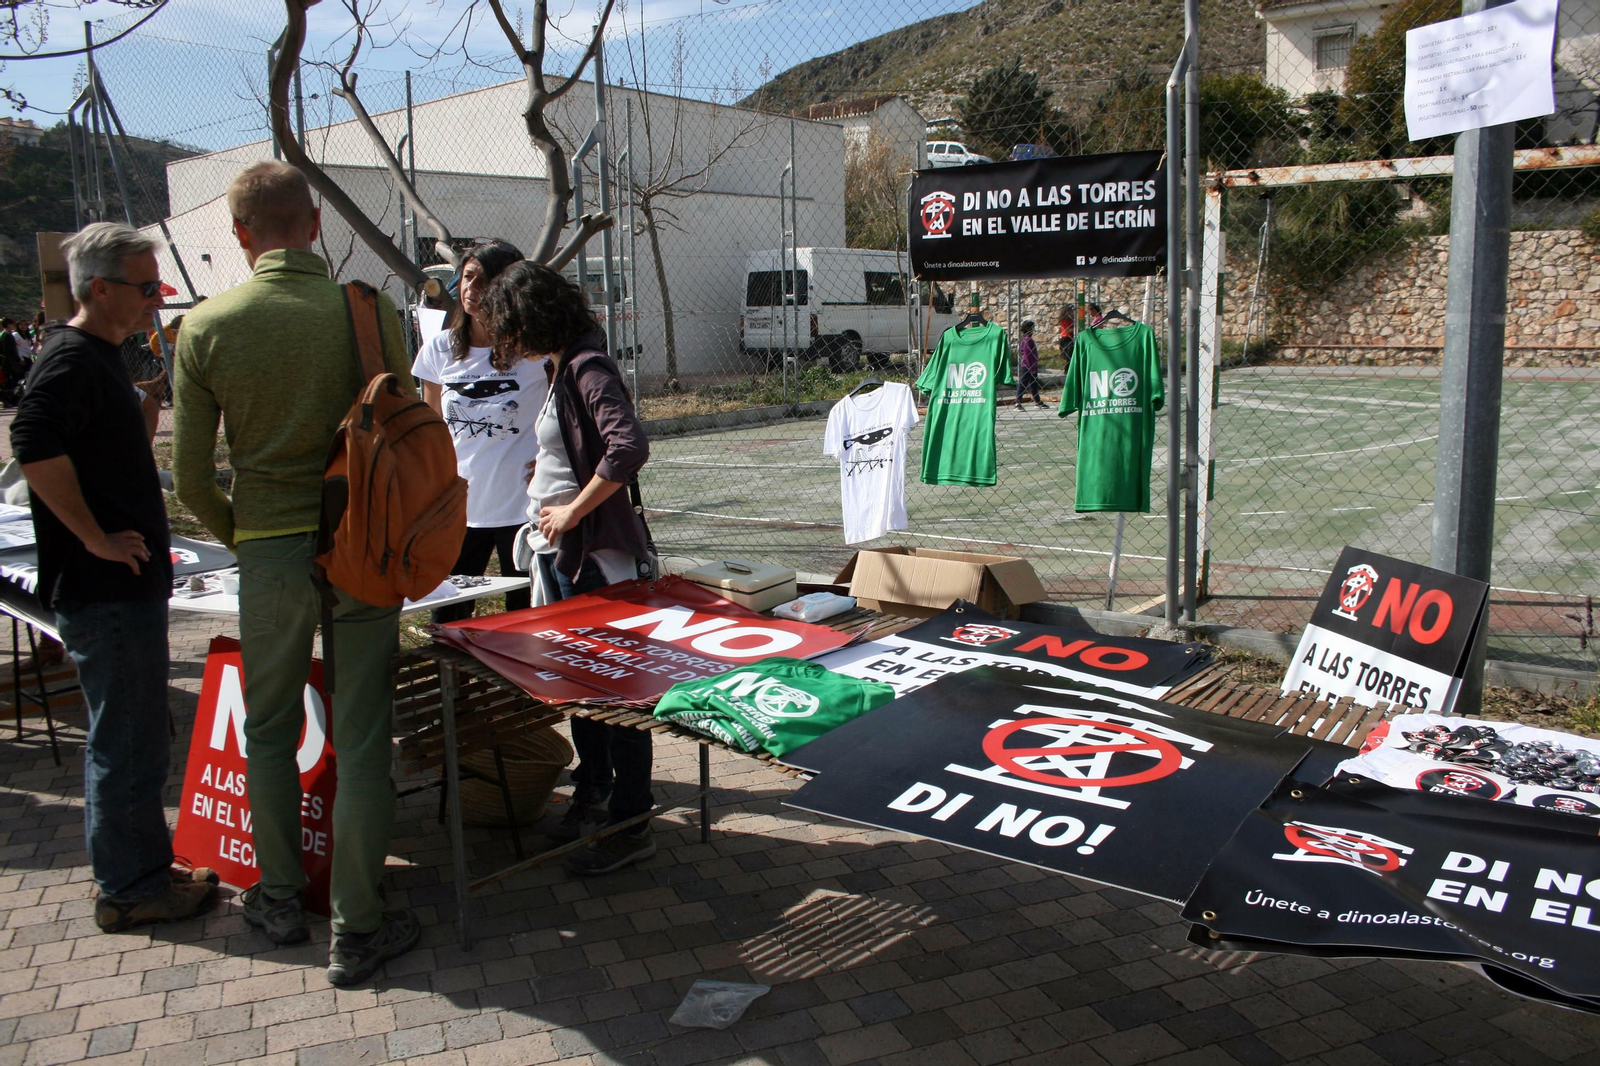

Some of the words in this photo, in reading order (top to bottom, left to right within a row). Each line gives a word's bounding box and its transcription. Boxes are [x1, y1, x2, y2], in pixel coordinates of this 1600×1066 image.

[1418, 51, 1442, 60] CAMISETAS
[1446, 46, 1460, 55] VERDE
[1418, 62, 1442, 72] PANCARTAS
[1471, 52, 1484, 60] PARA
[1485, 46, 1508, 57] BALCONES
[1418, 74, 1442, 84] PANCARTAS
[1476, 63, 1489, 71] PARA
[1489, 58, 1512, 68] BALCONES
[1417, 88, 1435, 97] CHAPAS
[963, 191, 980, 211] DI
[986, 189, 1011, 210] NO
[1017, 188, 1030, 208] A
[1037, 185, 1071, 206] LAS
[1078, 180, 1156, 203] TORRES
[962, 218, 982, 236] EN
[988, 216, 1006, 235] EL
[1010, 213, 1061, 234] VALLE
[1067, 212, 1089, 231] DE
[1094, 205, 1156, 230] LECRÍN
[948, 260, 1000, 268] dinoalastorres.org
[1102, 255, 1156, 264] @dinoalastorres
[1093, 400, 1106, 408] LAS
[1108, 398, 1137, 406] TORRES
[1371, 577, 1454, 645] NO
[605, 604, 803, 658] NO
[532, 629, 573, 644] EN
[563, 640, 598, 653] EL
[597, 649, 677, 675] VALLE
[541, 650, 635, 681] LECRÍN
[567, 626, 594, 635] A
[586, 632, 639, 648] LAS
[635, 644, 735, 674] TORRES
[882, 646, 911, 656] A
[913, 652, 978, 666] LAS
[1013, 634, 1149, 671] NO
[865, 660, 916, 675] EN
[914, 669, 957, 680] E
[1302, 642, 1317, 666] A
[1318, 648, 1353, 680] LAS
[1355, 662, 1431, 709] TORRES
[200, 763, 212, 786] A
[215, 767, 246, 797] LAS
[192, 792, 213, 820] EN
[216, 800, 235, 829] EL
[302, 826, 327, 856] DE
[886, 781, 974, 822] DI
[974, 802, 1116, 856] NO!
[1441, 851, 1510, 882] DI
[1244, 889, 1311, 916] Únete
[1316, 907, 1331, 920] a
[1426, 878, 1508, 913] EN
[1530, 898, 1600, 932] EL
